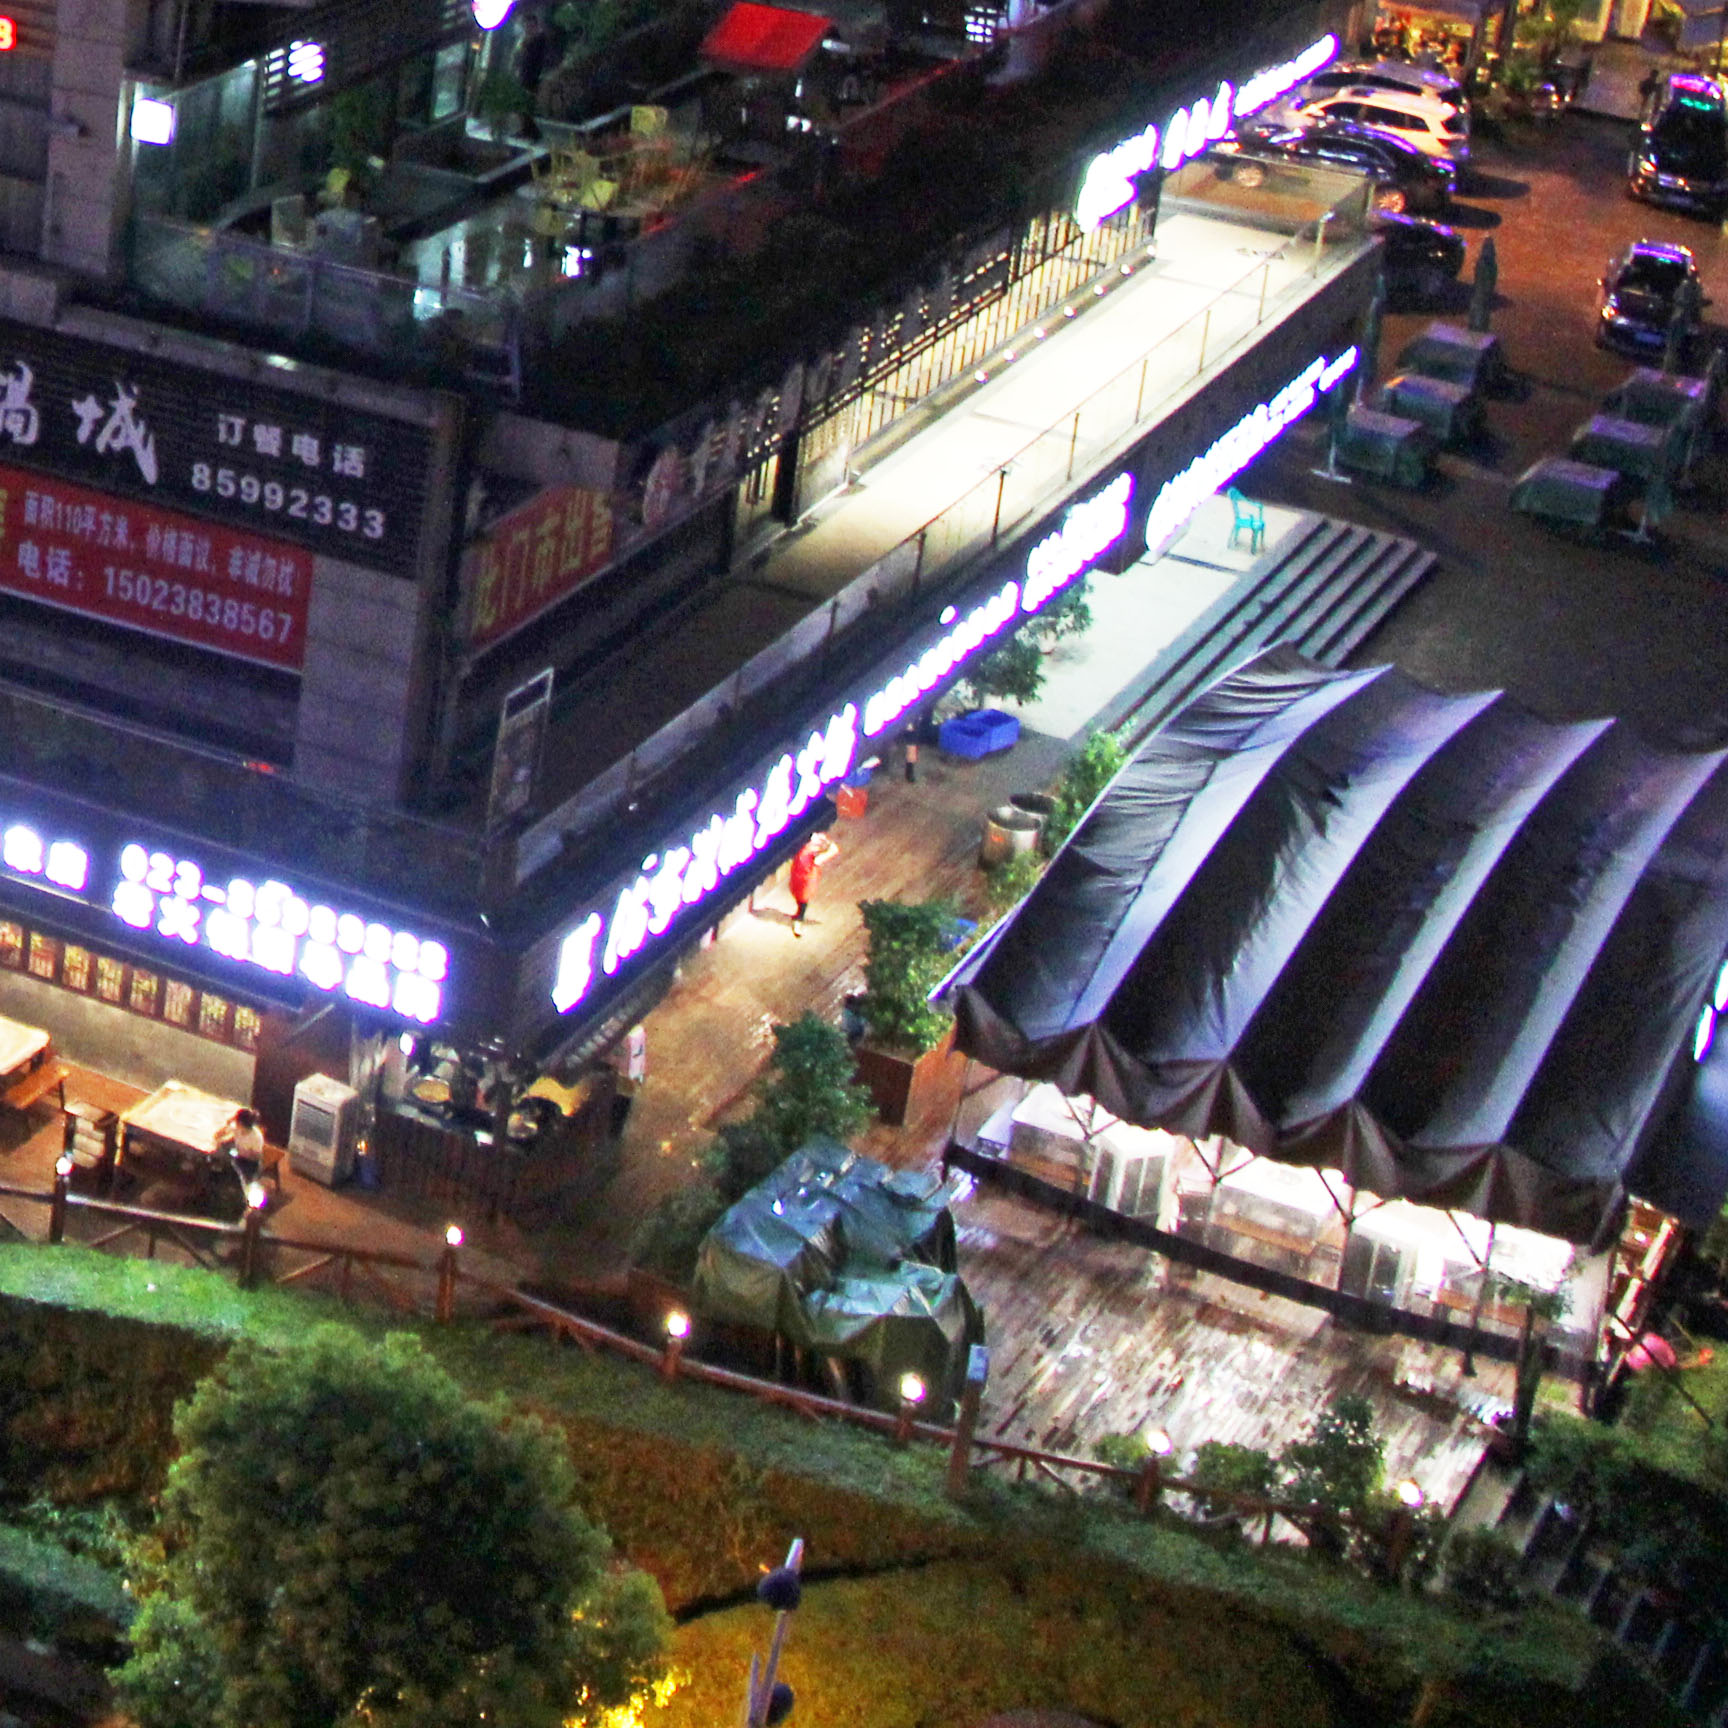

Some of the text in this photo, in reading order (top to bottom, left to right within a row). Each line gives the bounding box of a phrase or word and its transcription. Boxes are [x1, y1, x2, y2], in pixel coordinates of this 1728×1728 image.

[217, 413, 365, 478] 订餐电话
[191, 462, 384, 539] 85992333
[102, 565, 293, 645] 15023838567
